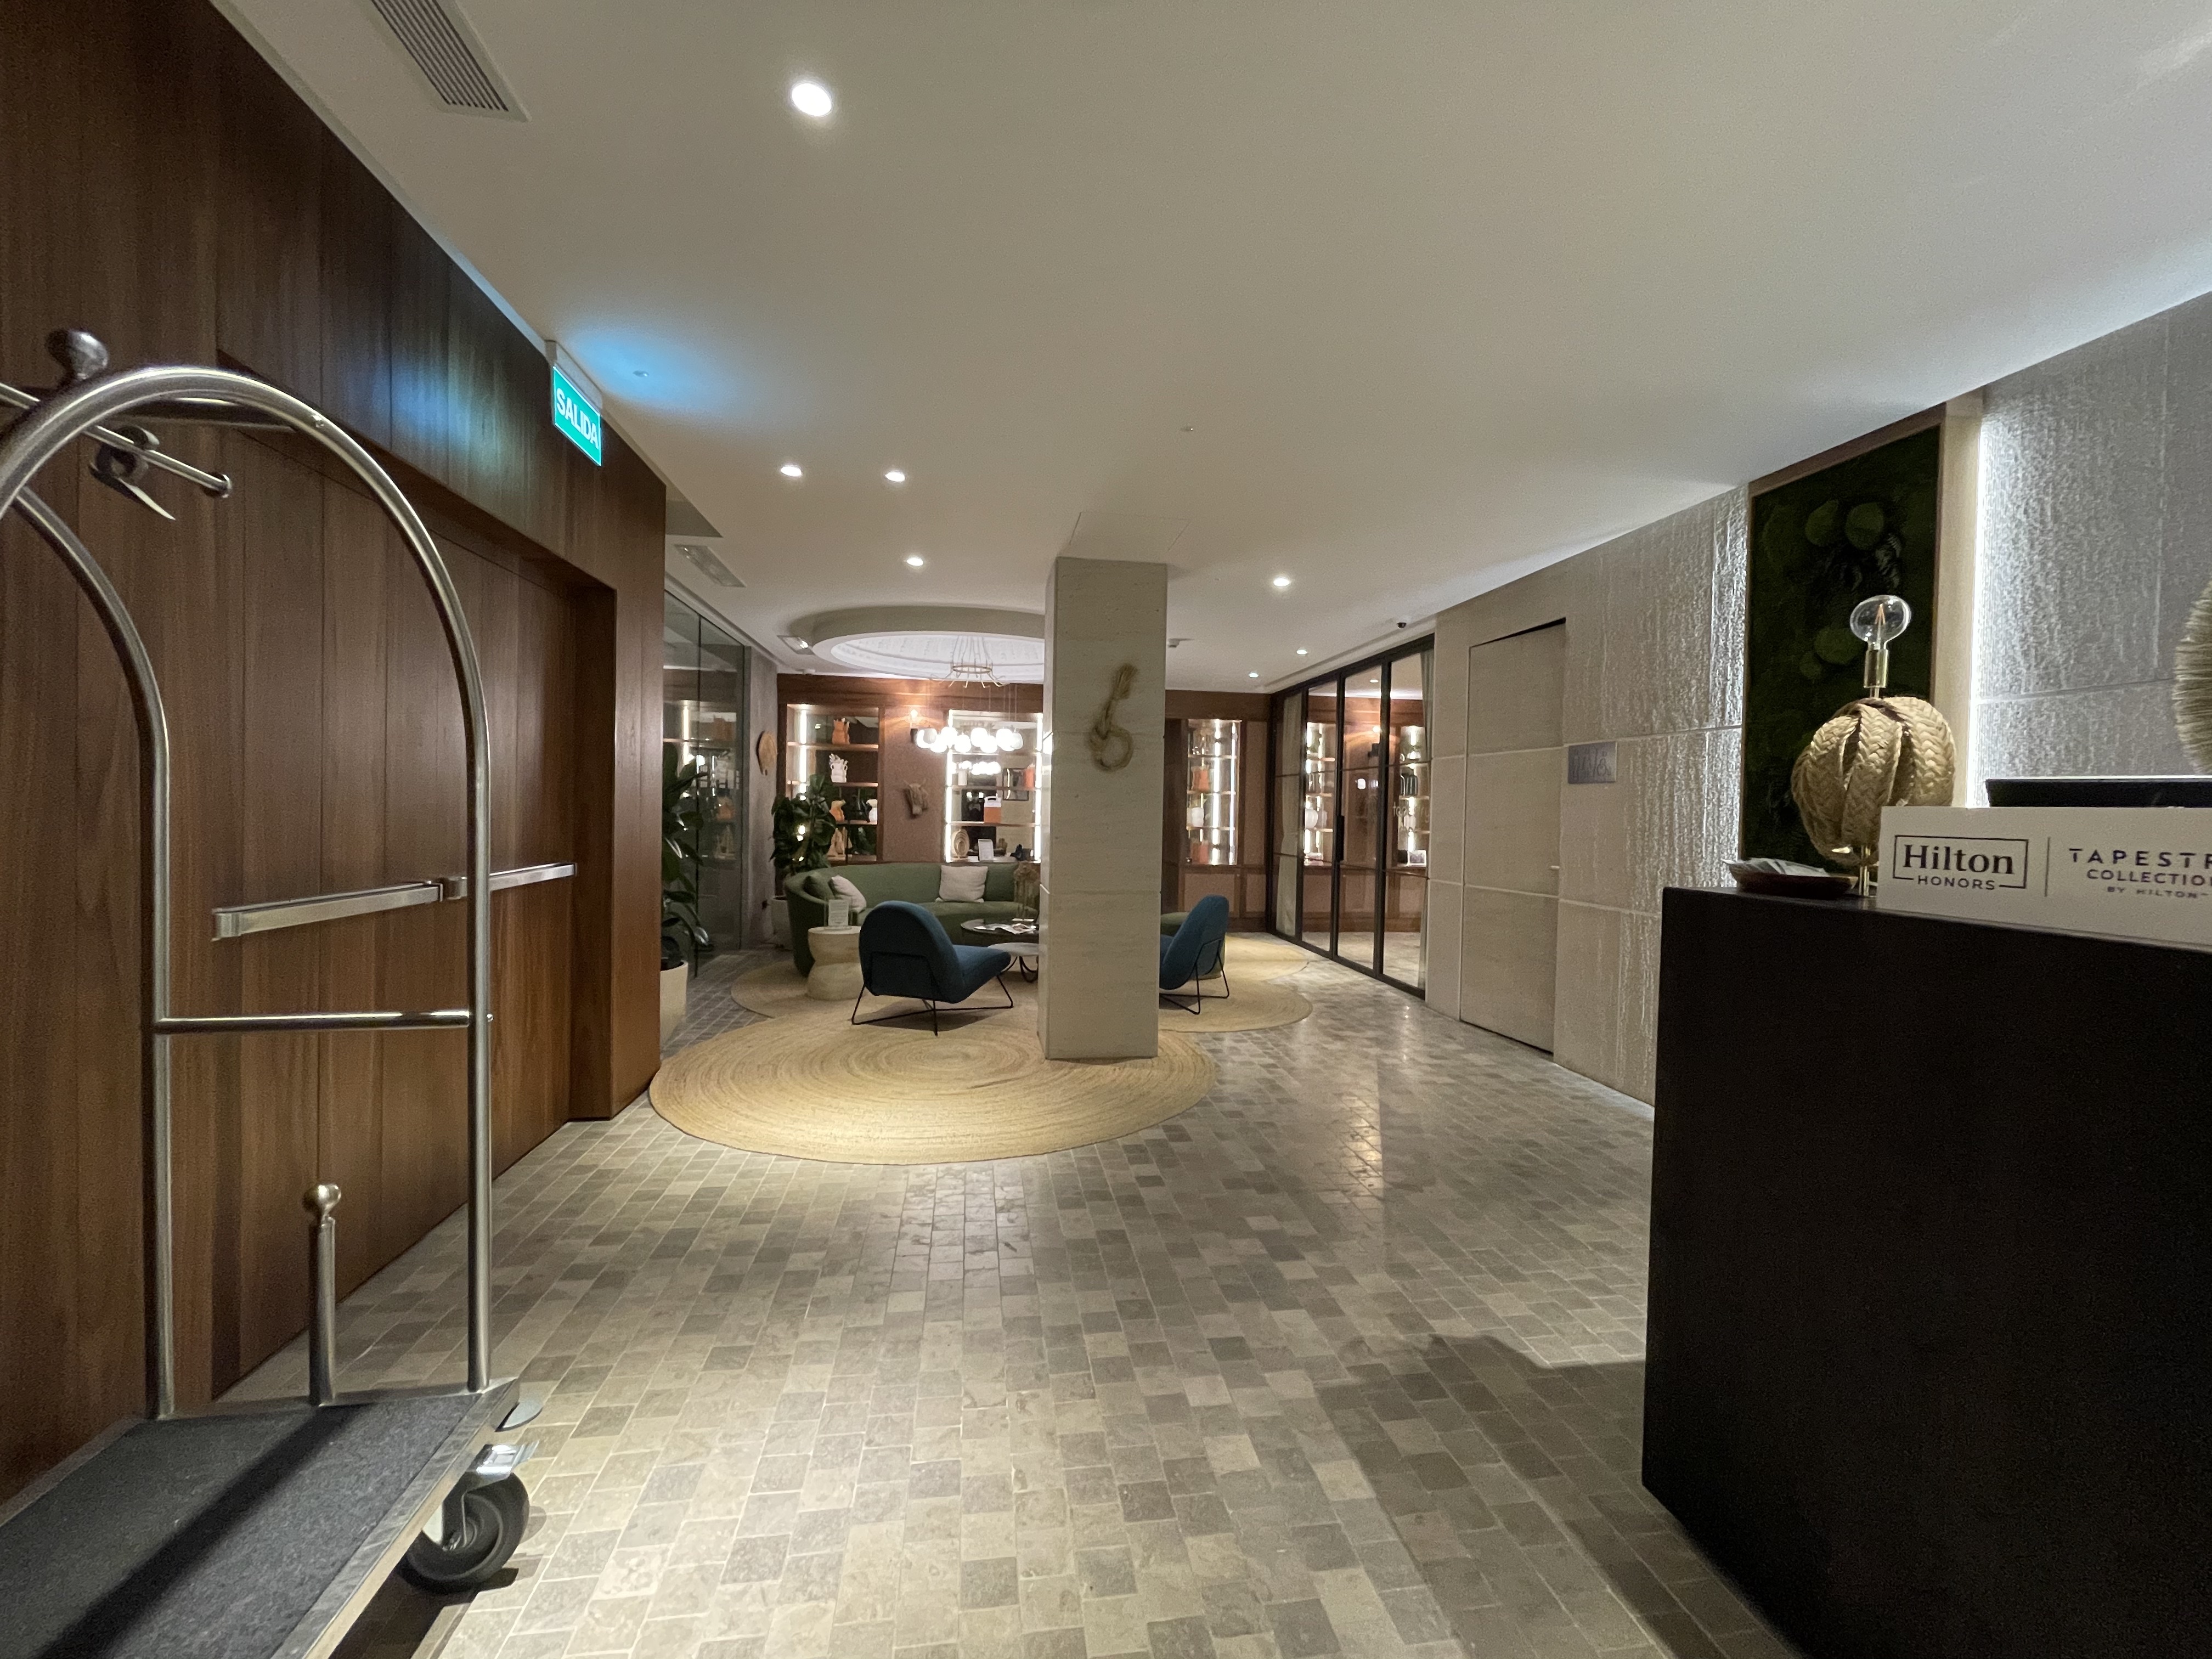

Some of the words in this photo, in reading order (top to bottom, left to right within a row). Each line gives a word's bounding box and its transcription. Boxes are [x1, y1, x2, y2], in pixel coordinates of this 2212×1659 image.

[556, 388, 599, 450] SALIDA
[1903, 844, 2014, 874] Hilton
[1917, 875, 1995, 890] HONORS
[2086, 869, 2212, 886] COLLECTIO
